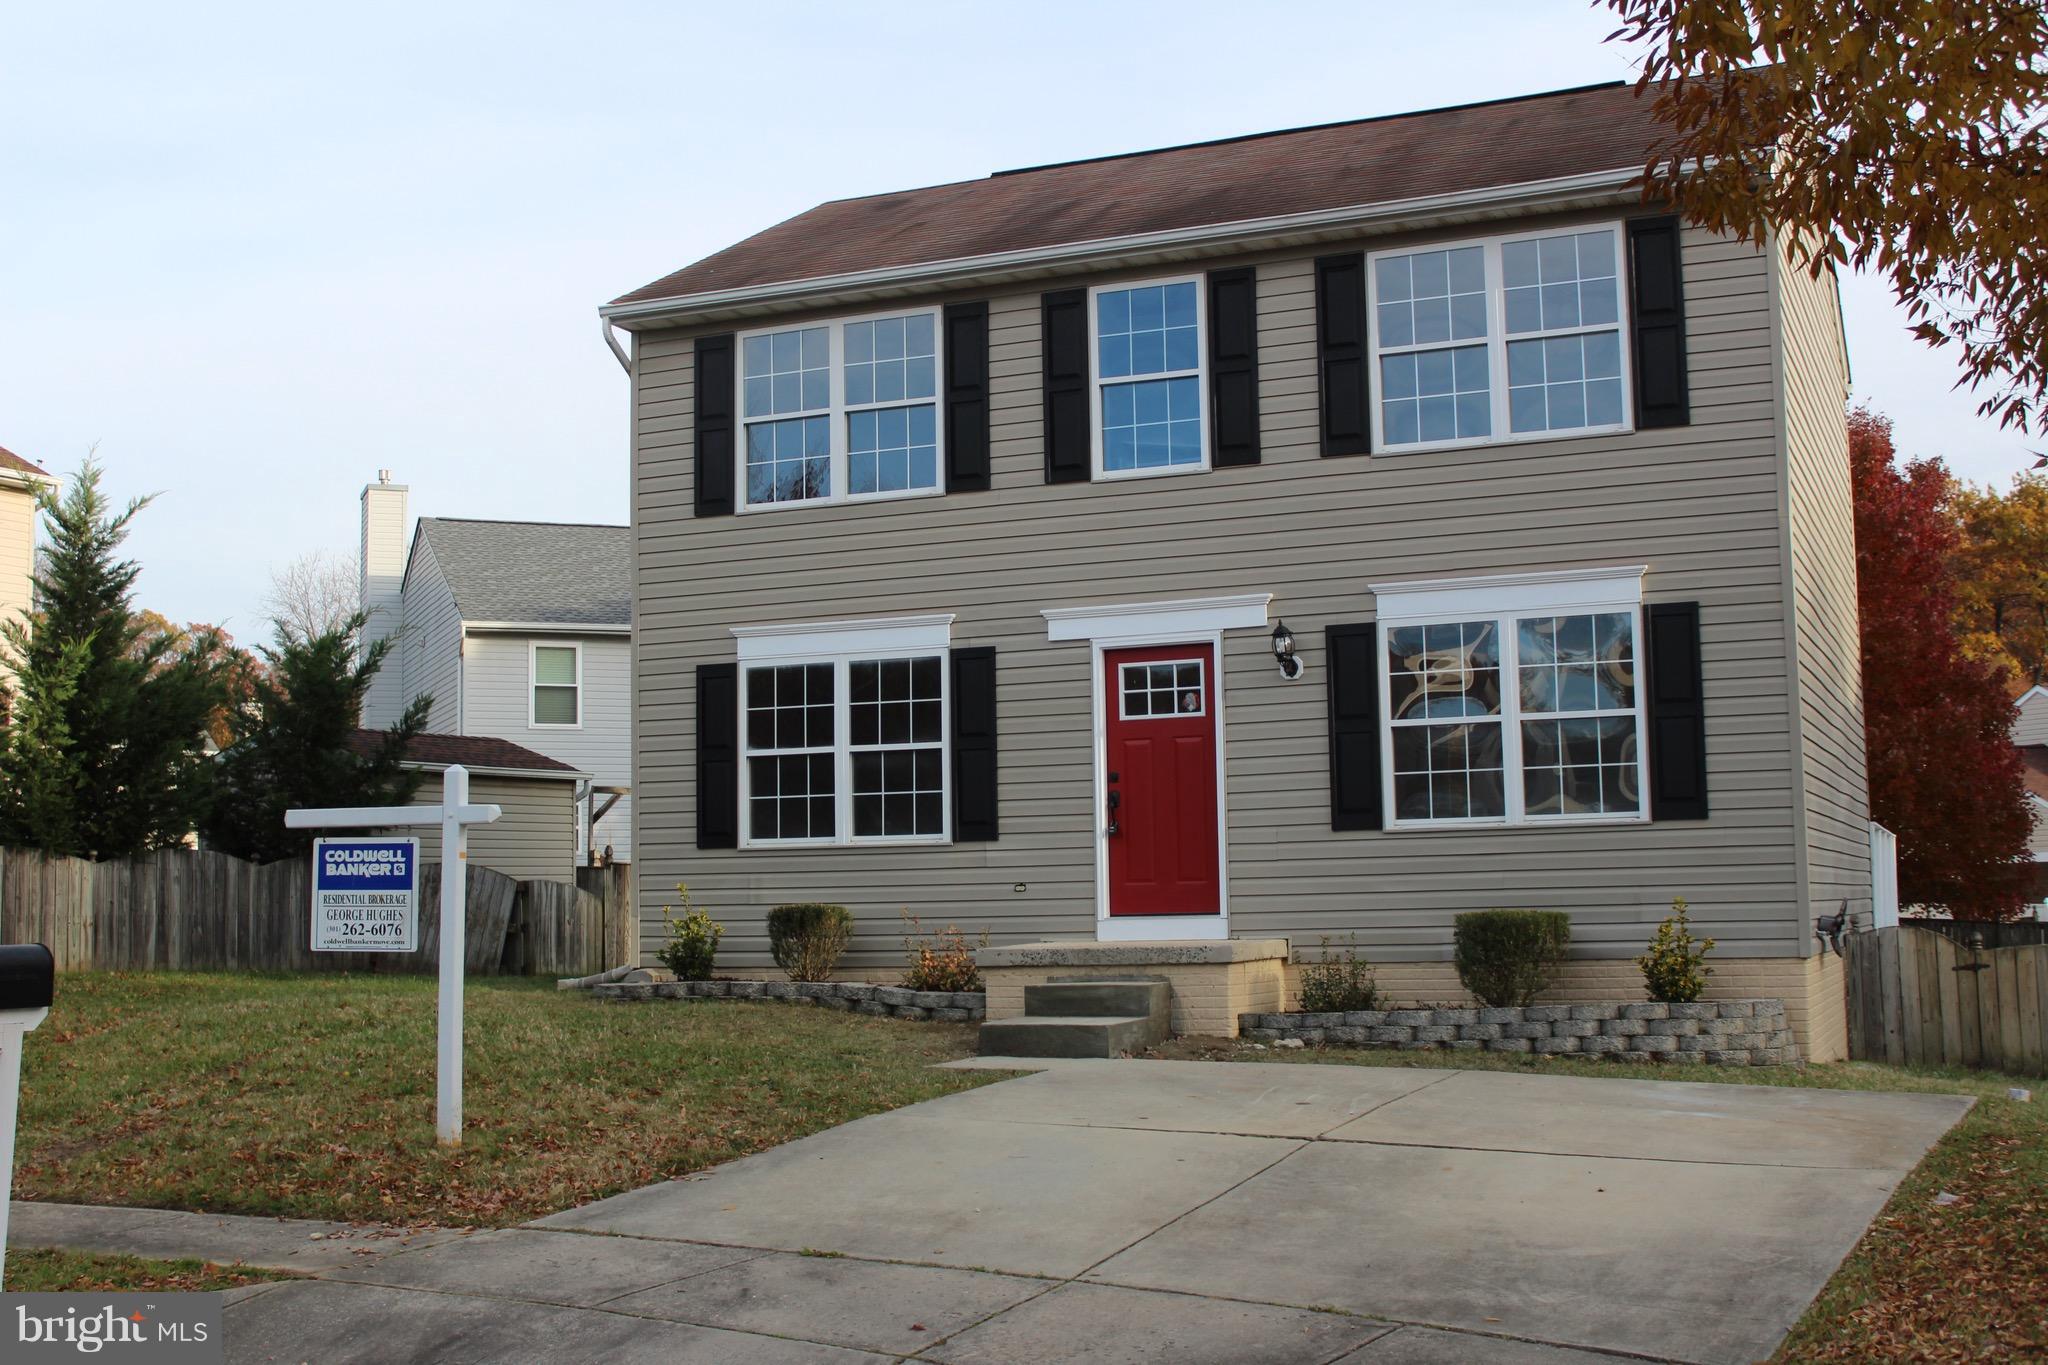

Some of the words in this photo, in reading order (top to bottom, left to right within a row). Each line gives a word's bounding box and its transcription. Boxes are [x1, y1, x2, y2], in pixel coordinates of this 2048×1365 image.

[323, 894, 366, 904] RESIDENTIAL
[368, 894, 407, 904] BROKERAGE
[326, 909, 364, 921] GEORGE
[366, 909, 403, 921] HUGHES
[342, 923, 402, 936] 262-6076
